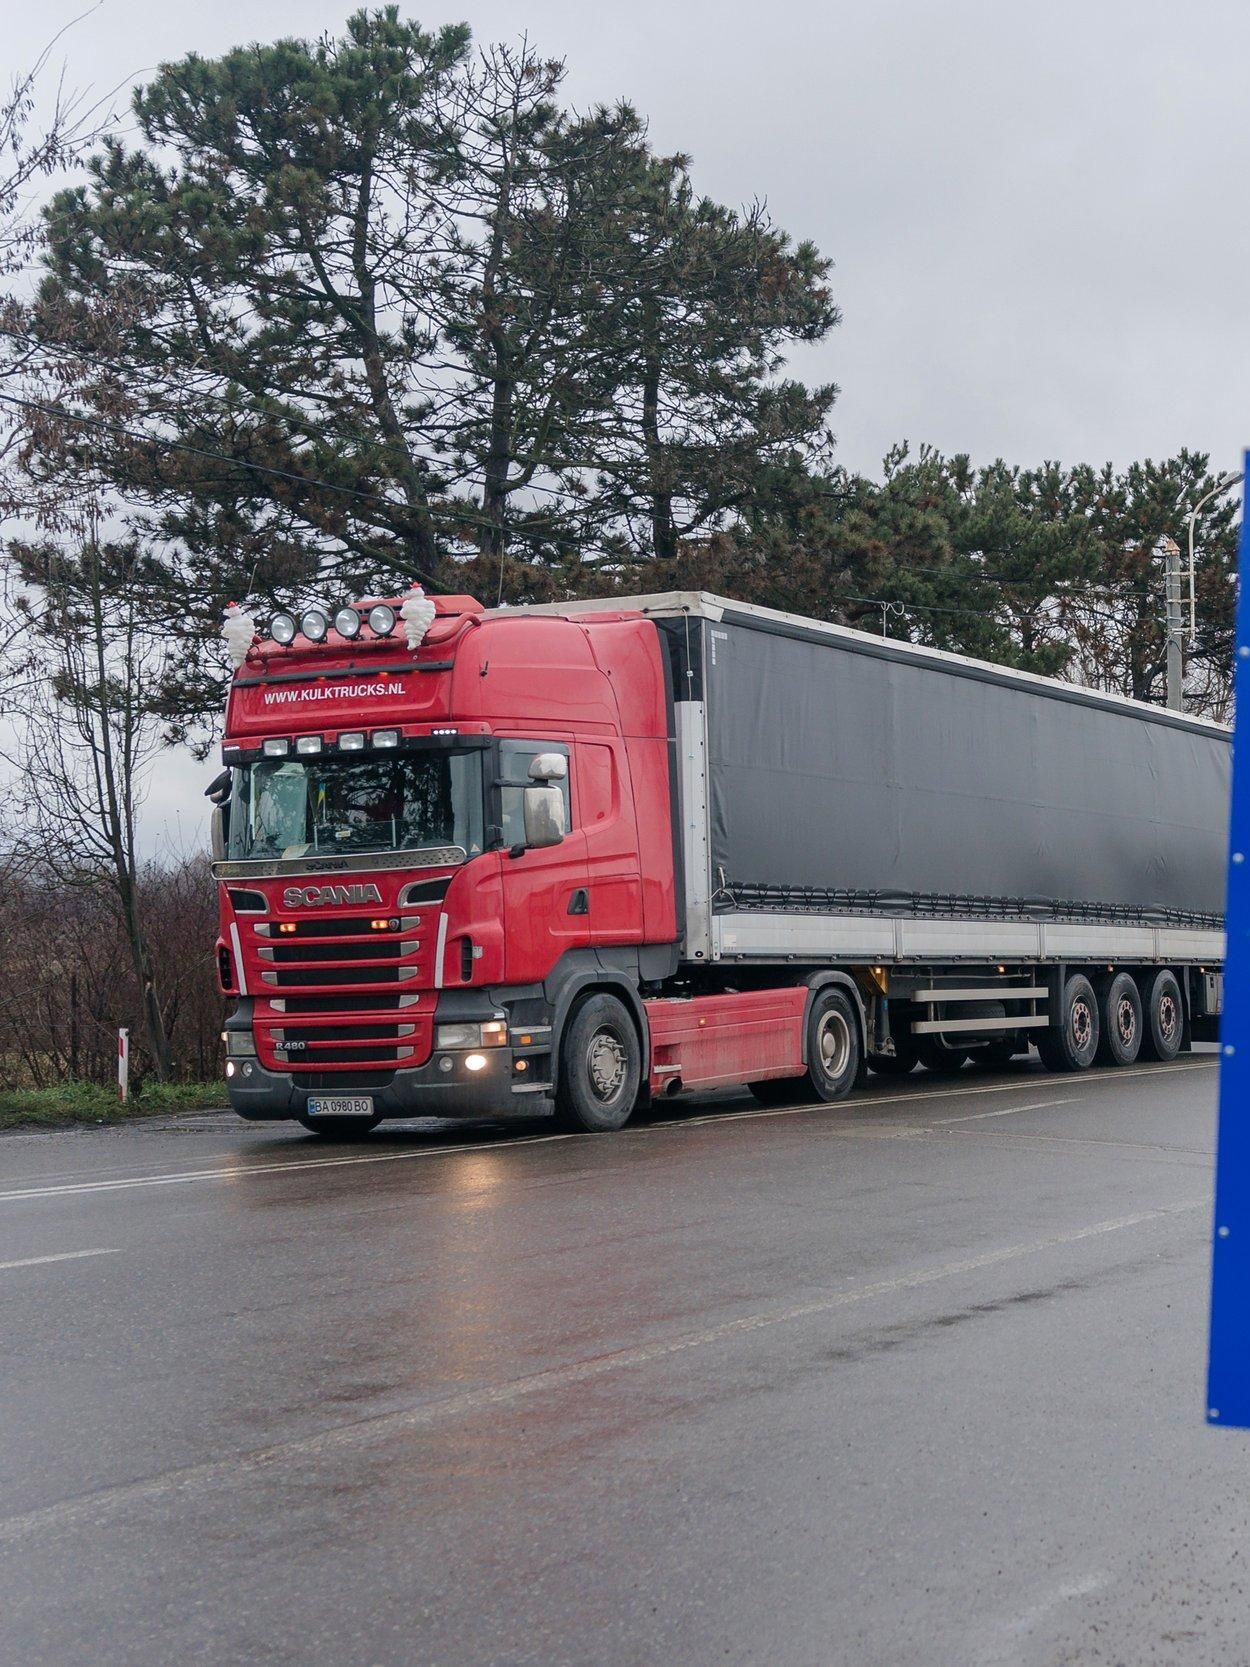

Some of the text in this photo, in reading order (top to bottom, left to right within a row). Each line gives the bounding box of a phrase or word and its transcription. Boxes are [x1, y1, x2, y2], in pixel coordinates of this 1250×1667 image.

[264, 682, 406, 705] WWW.KULKTRUCKS.NL
[283, 883, 383, 908] SCANIA
[315, 1100, 368, 1112] BA 0980 BO
